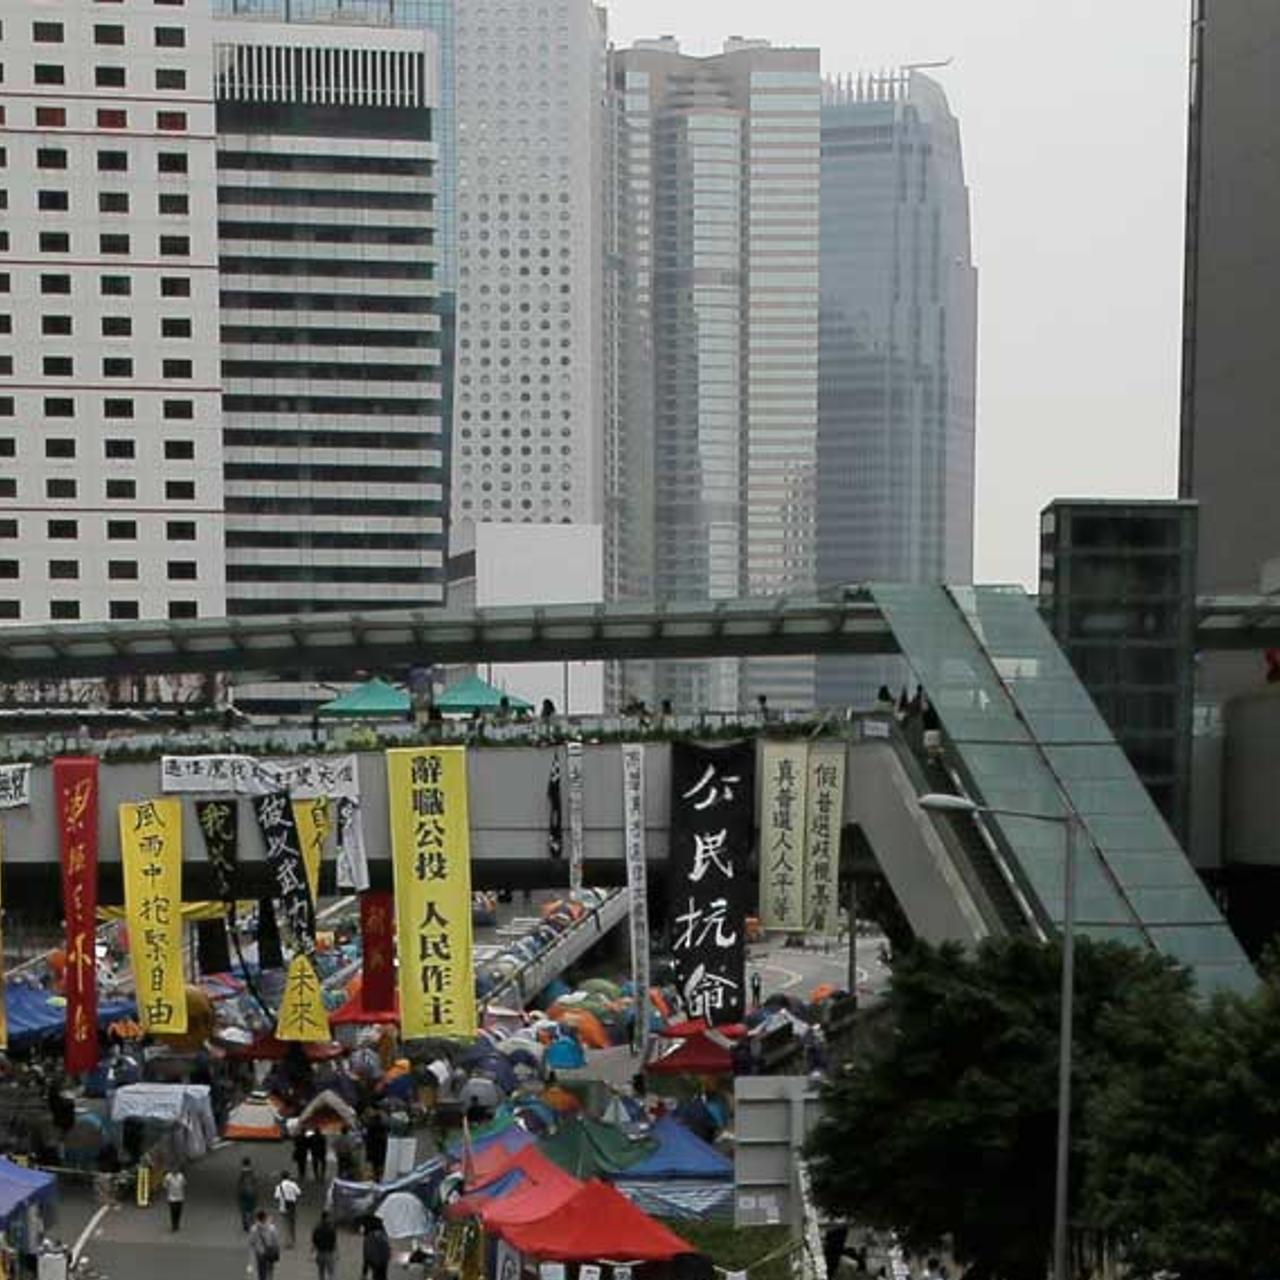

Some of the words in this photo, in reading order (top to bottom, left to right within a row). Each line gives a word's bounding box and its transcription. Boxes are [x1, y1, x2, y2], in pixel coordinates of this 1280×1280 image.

[411, 757, 449, 881] 辭職公投
[673, 763, 741, 1025] 公民抗命
[771, 759, 797, 922] 真普選人人平等
[132, 799, 174, 1028] 風雨中抱緊自由
[418, 901, 454, 1027] 人民作主
